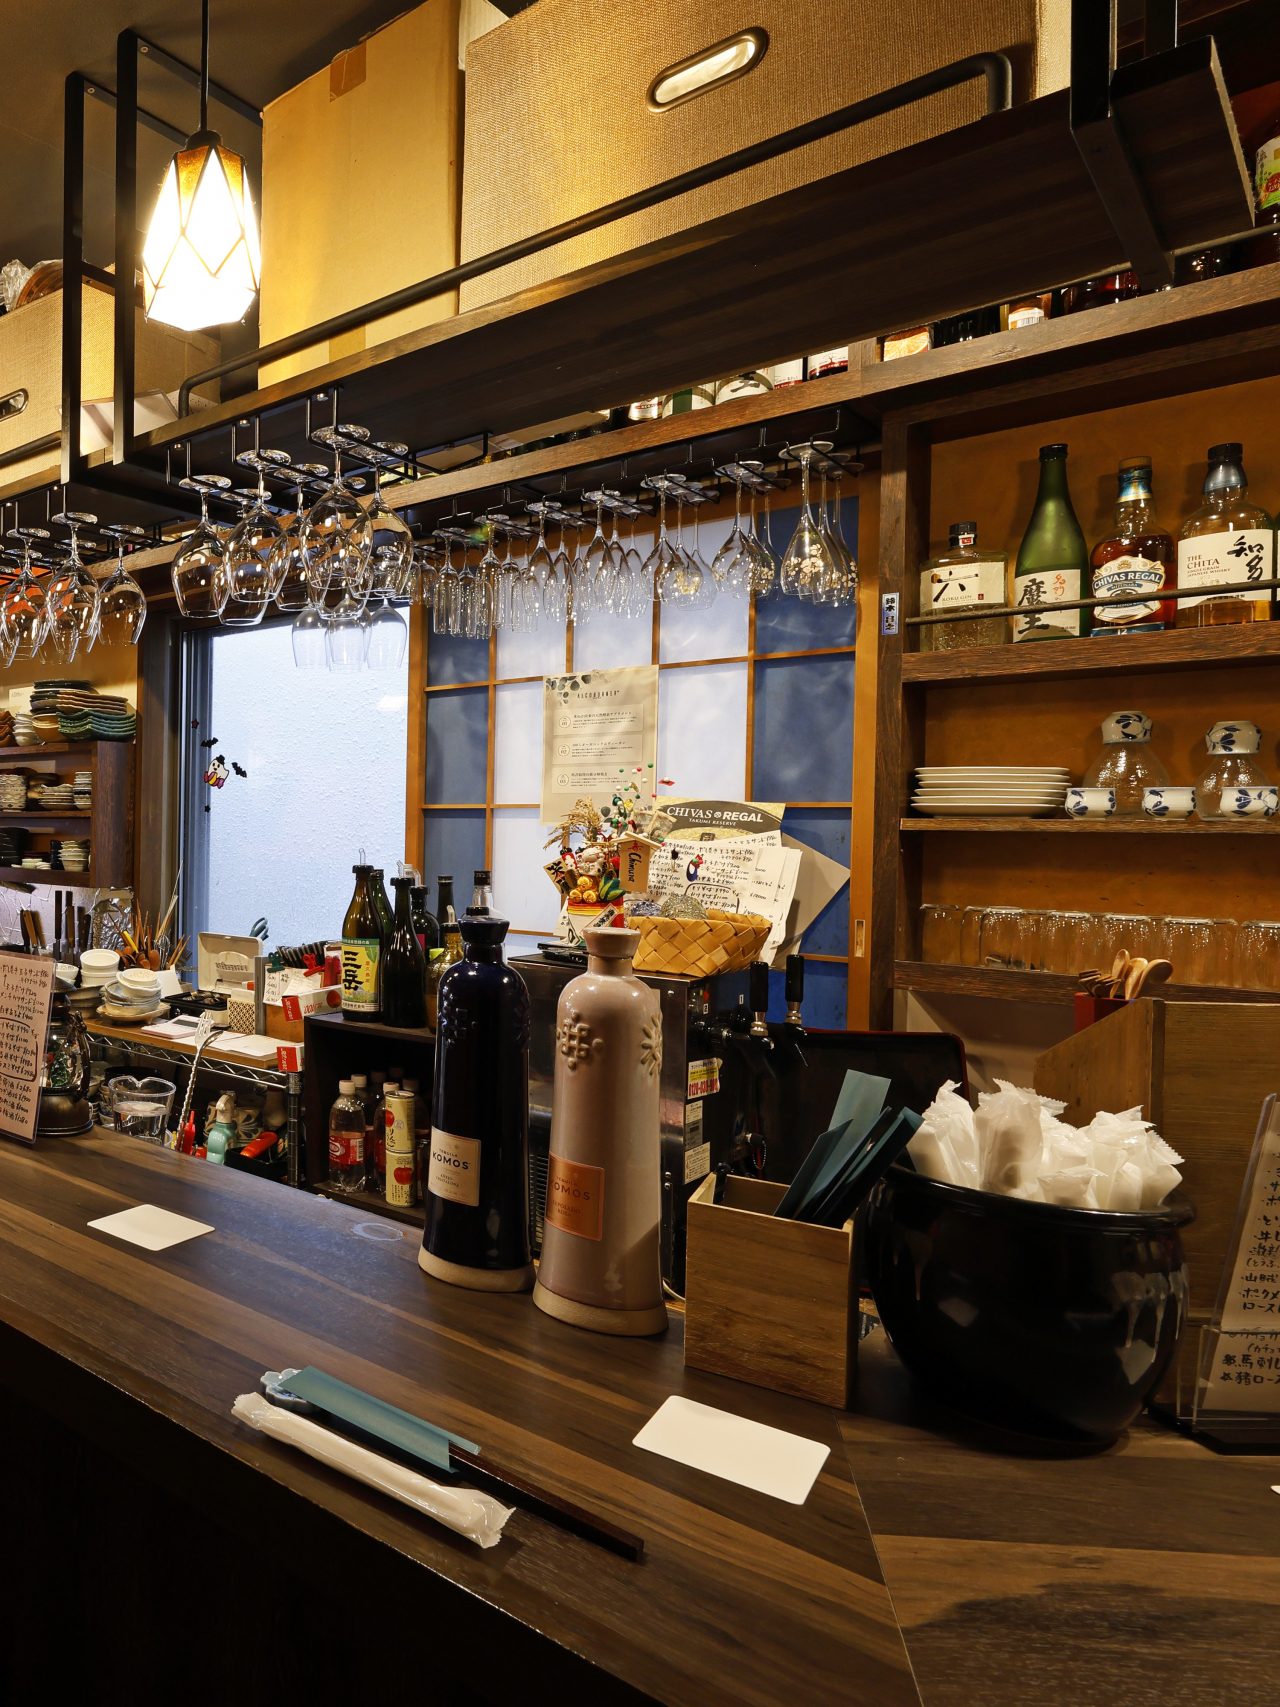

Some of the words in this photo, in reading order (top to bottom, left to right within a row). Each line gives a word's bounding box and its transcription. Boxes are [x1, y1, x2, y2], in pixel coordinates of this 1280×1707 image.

[1187, 554, 1202, 562] THE
[1187, 558, 1220, 570] CHITA
[1094, 573, 1126, 589] CHIVAS
[1127, 572, 1161, 584] REGAL
[667, 806, 713, 818] CHIVAS
[723, 811, 764, 822] REGAL
[433, 1151, 470, 1170] KOMOS
